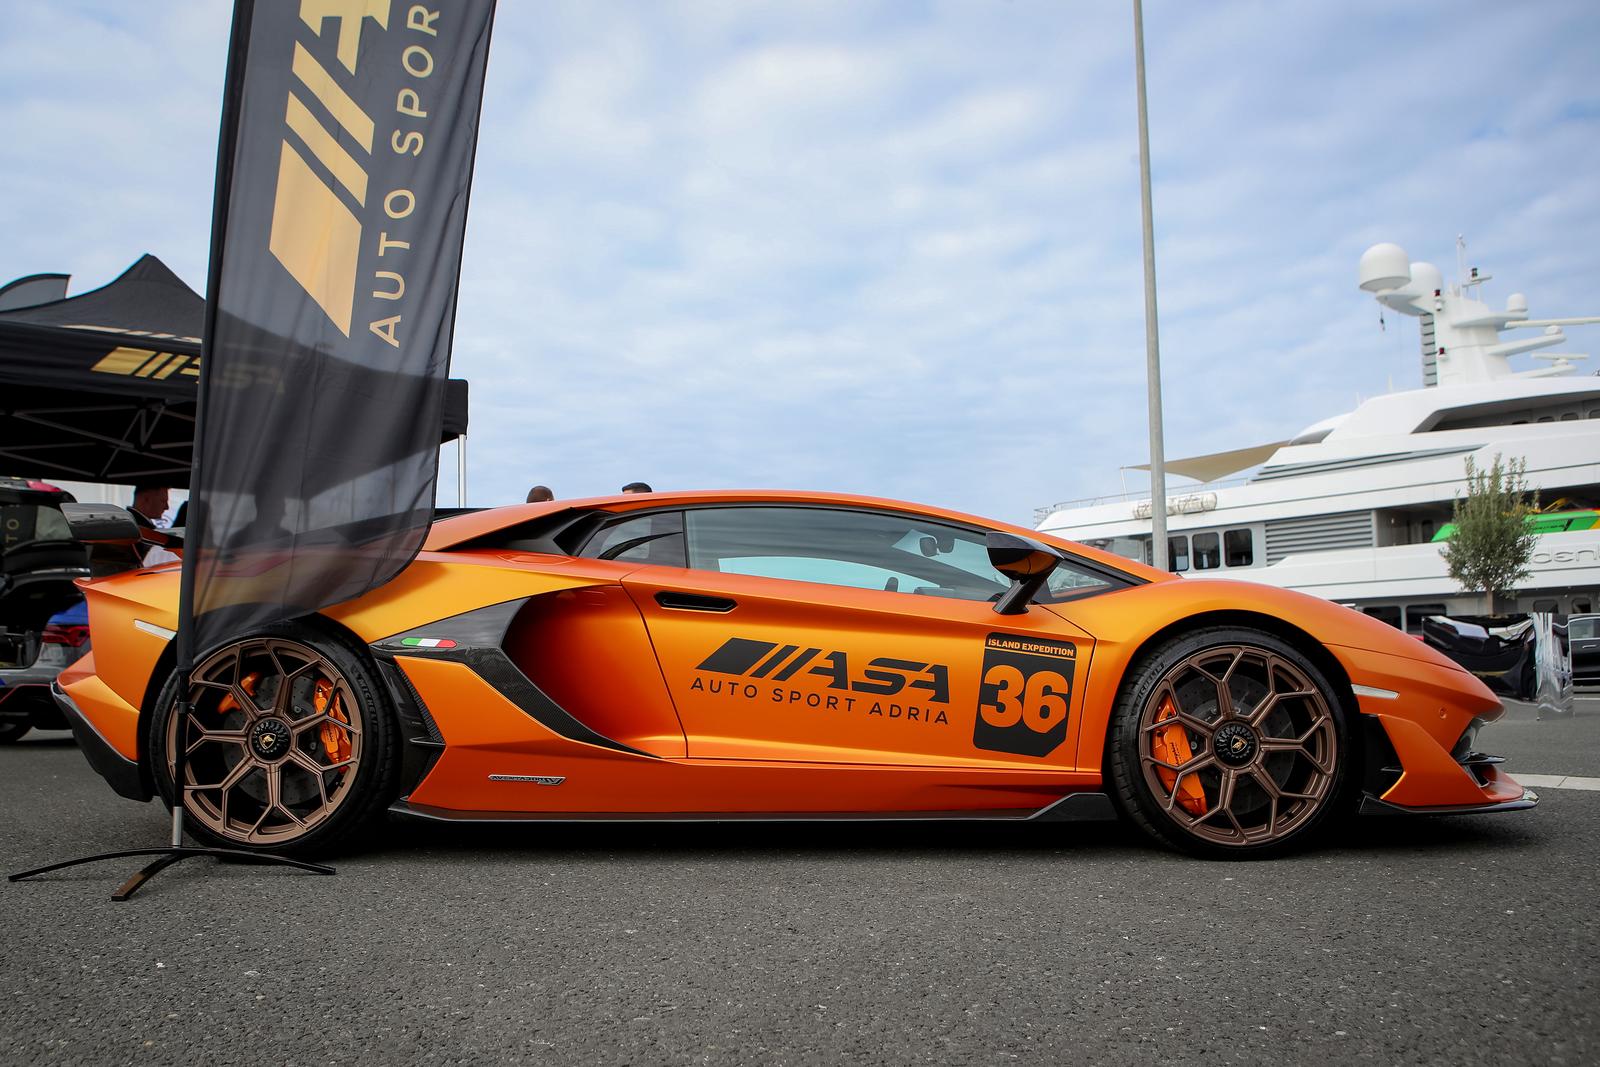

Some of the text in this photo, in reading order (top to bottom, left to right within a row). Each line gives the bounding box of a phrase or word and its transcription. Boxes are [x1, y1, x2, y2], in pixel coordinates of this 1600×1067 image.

[369, 189, 416, 348] AUTO
[807, 650, 950, 704] ASA
[1021, 643, 1074, 657] EXPEDITION
[691, 677, 949, 725] AUTO SPORT ADRIA
[980, 664, 1069, 734] 36
